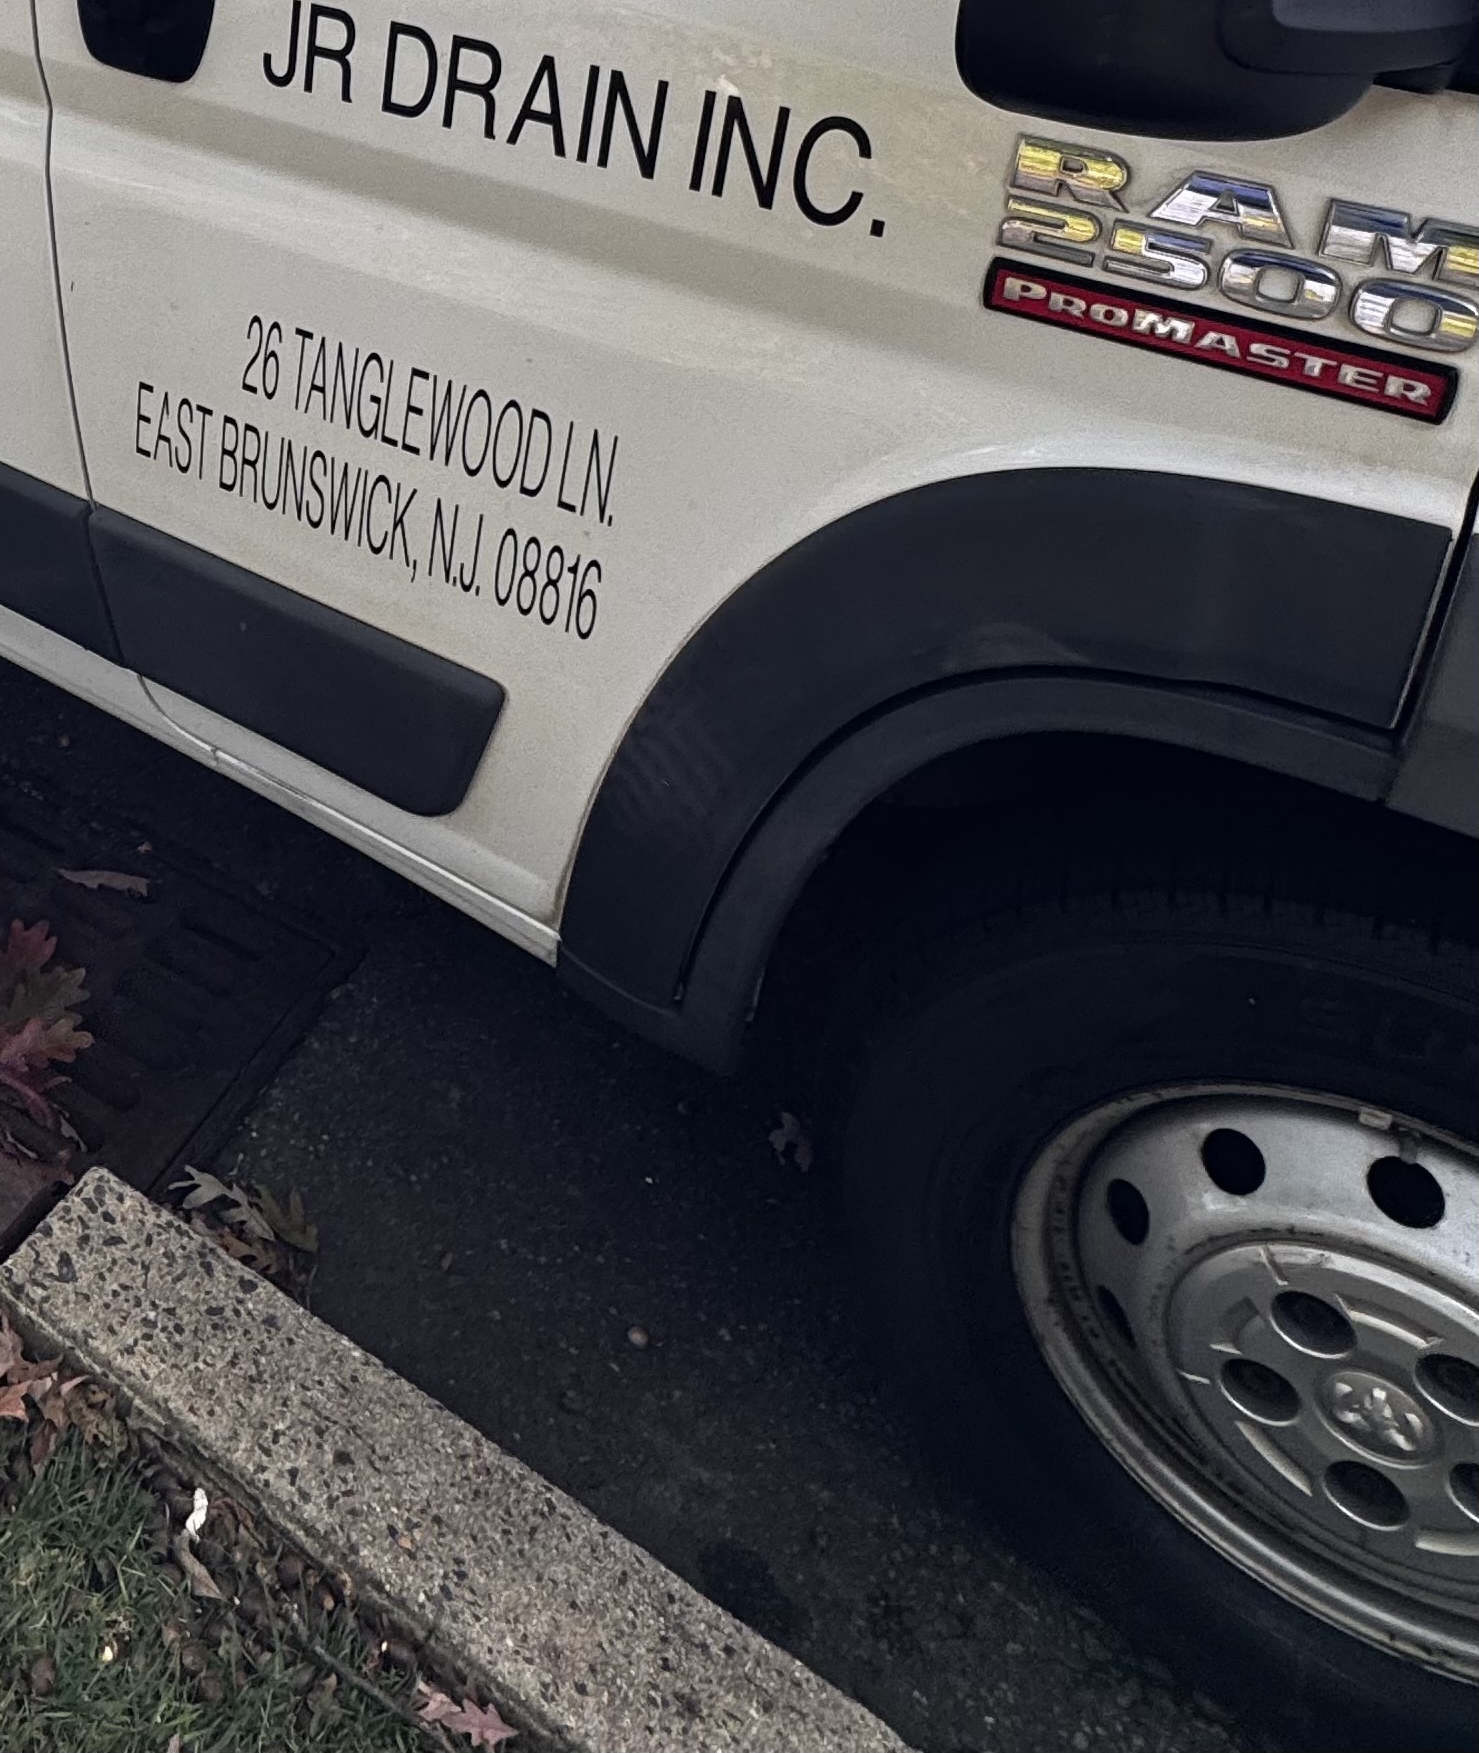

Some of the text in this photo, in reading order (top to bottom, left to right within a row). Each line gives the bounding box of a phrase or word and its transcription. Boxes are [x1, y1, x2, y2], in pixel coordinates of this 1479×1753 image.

[262, 0, 886, 238] JR DRAIN INC.
[1008, 133, 1479, 289] RAM
[996, 196, 1479, 353] 2500
[135, 381, 602, 640] EAST BRUNSWICK, N.J. 08816
[241, 315, 619, 527] 26 TANGLEWOOD LN.
